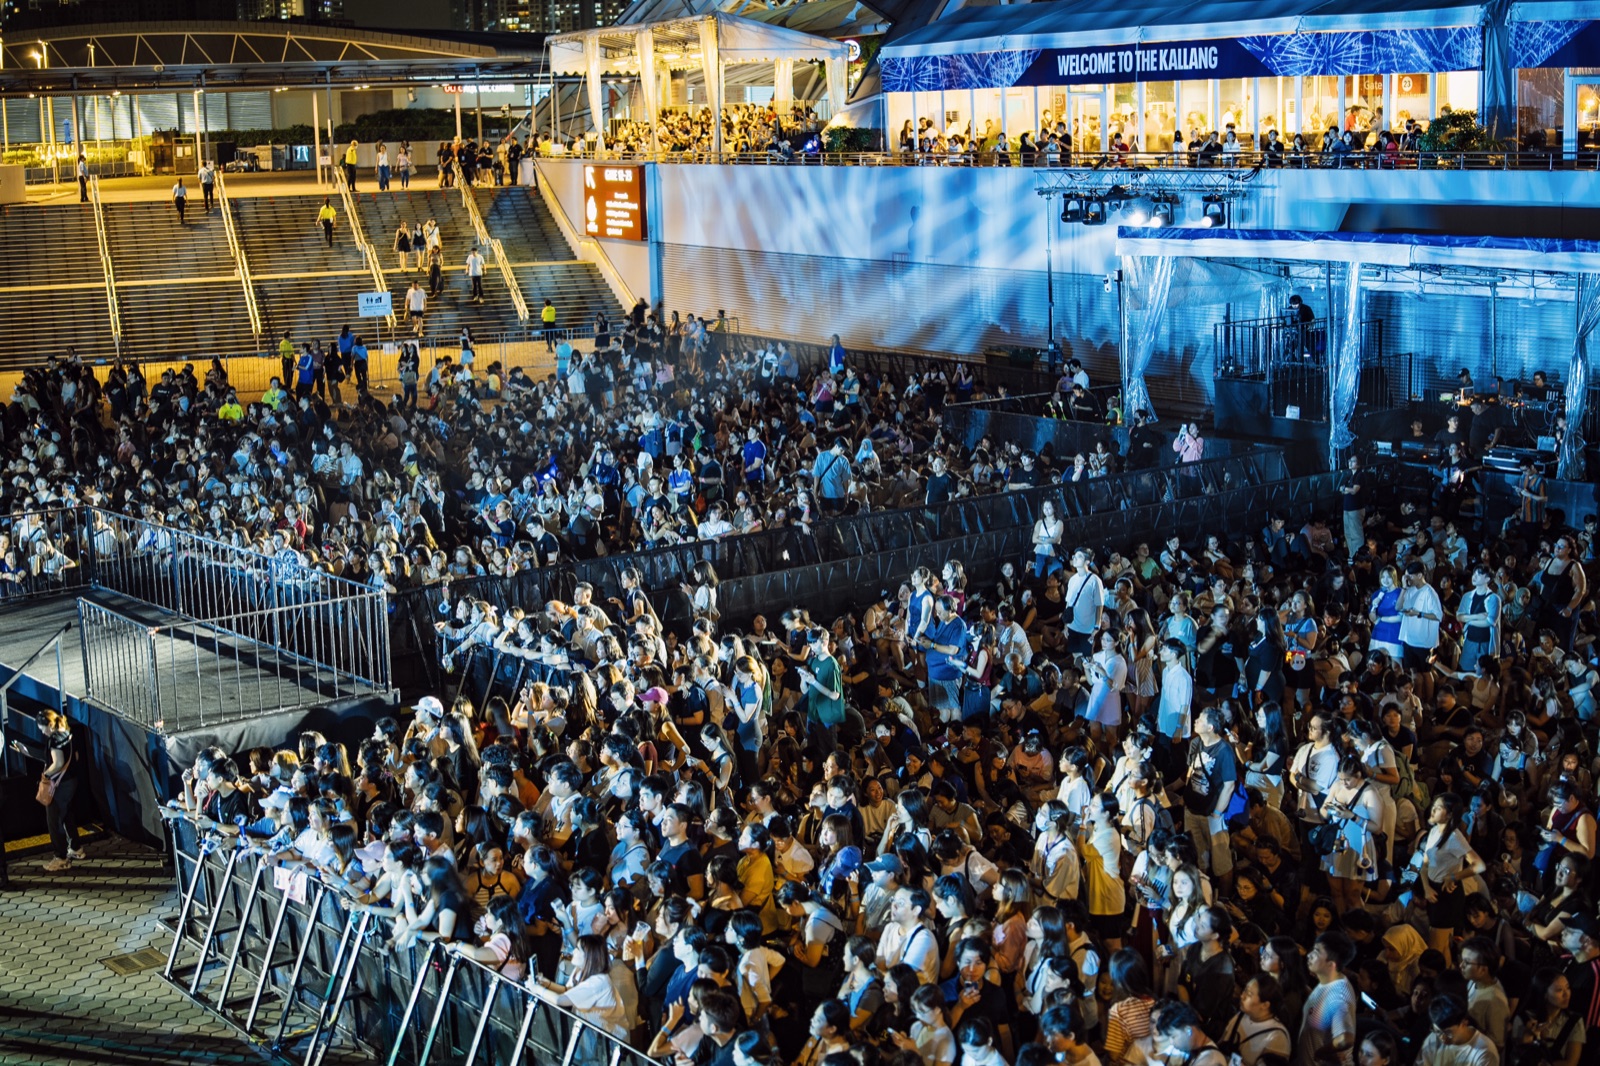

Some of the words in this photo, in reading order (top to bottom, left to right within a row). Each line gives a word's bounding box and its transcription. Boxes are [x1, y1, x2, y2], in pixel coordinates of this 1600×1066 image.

[1057, 52, 1116, 76] WELCOME
[1117, 50, 1133, 73] TO
[1135, 49, 1158, 72] THE
[1159, 46, 1218, 71] KALLANG
[1364, 80, 1382, 90] Gate
[1403, 80, 1411, 88] 23
